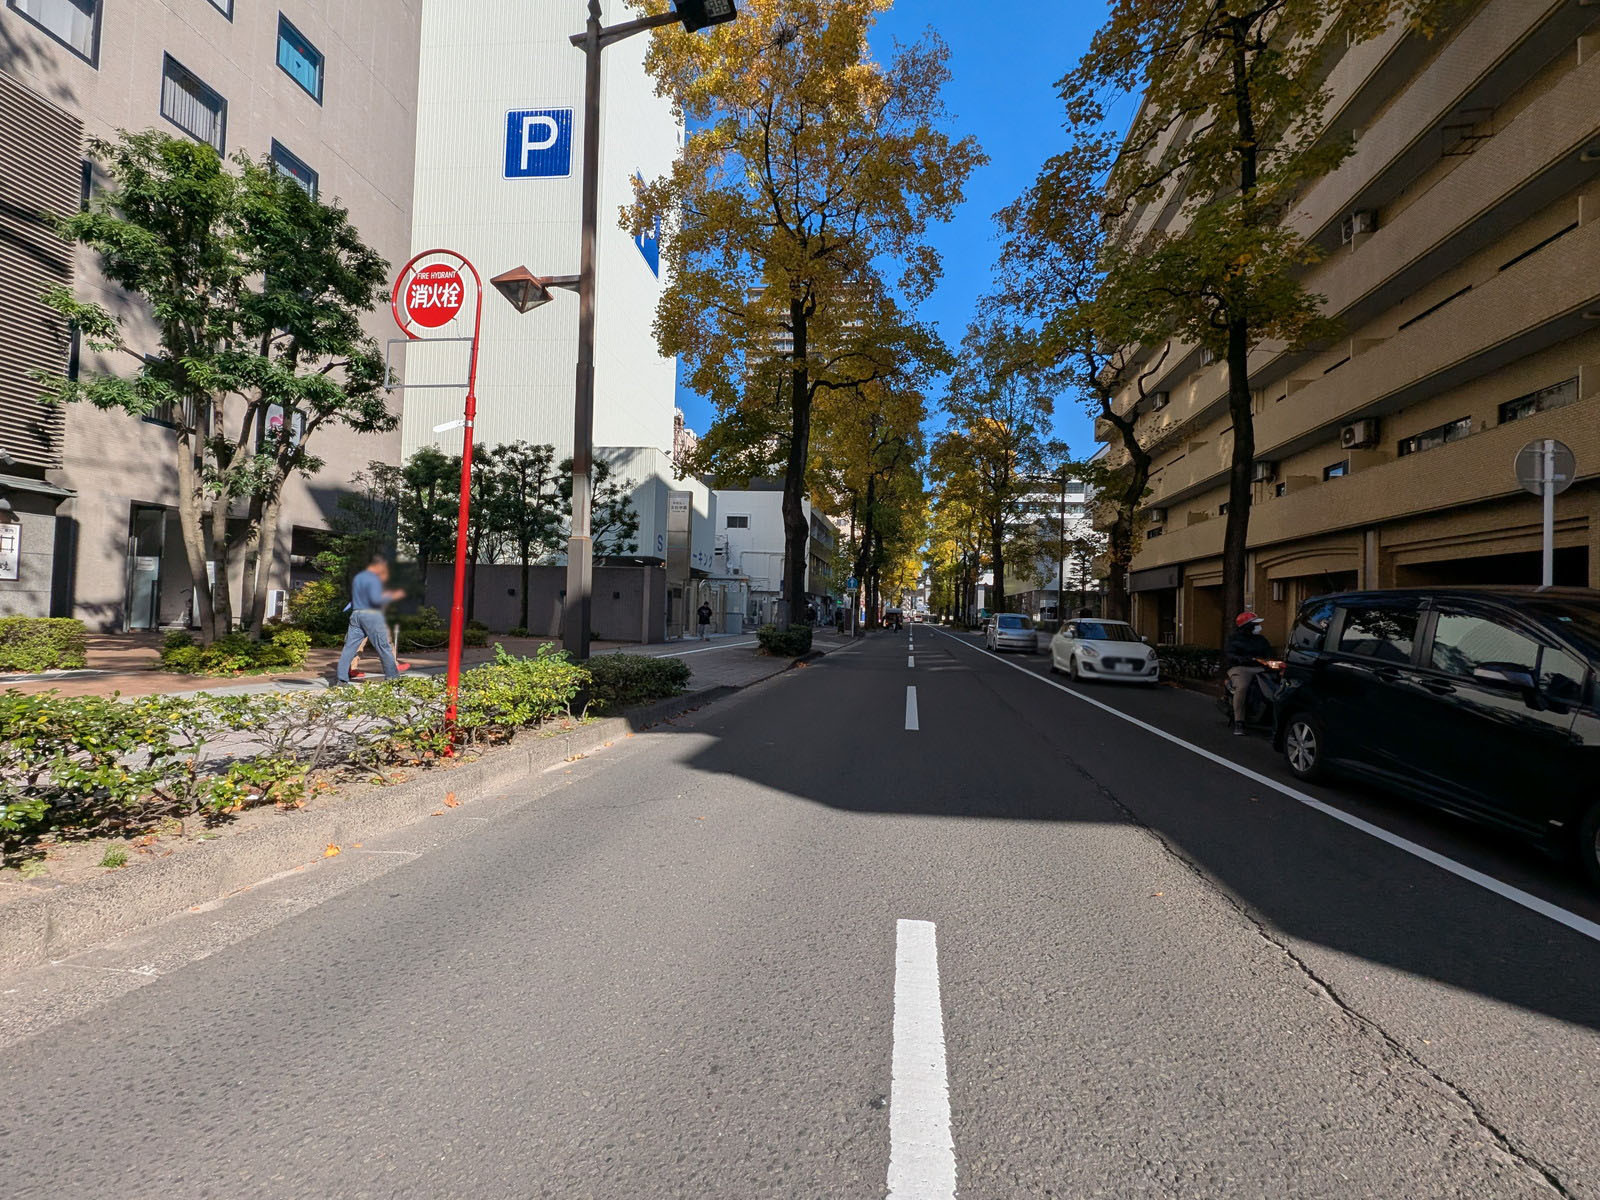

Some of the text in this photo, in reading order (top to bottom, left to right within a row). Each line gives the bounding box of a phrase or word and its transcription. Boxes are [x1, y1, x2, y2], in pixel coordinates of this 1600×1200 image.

[520, 116, 558, 170] P
[417, 271, 456, 280] FIRE HYDRANT
[410, 282, 461, 309] 消火栓
